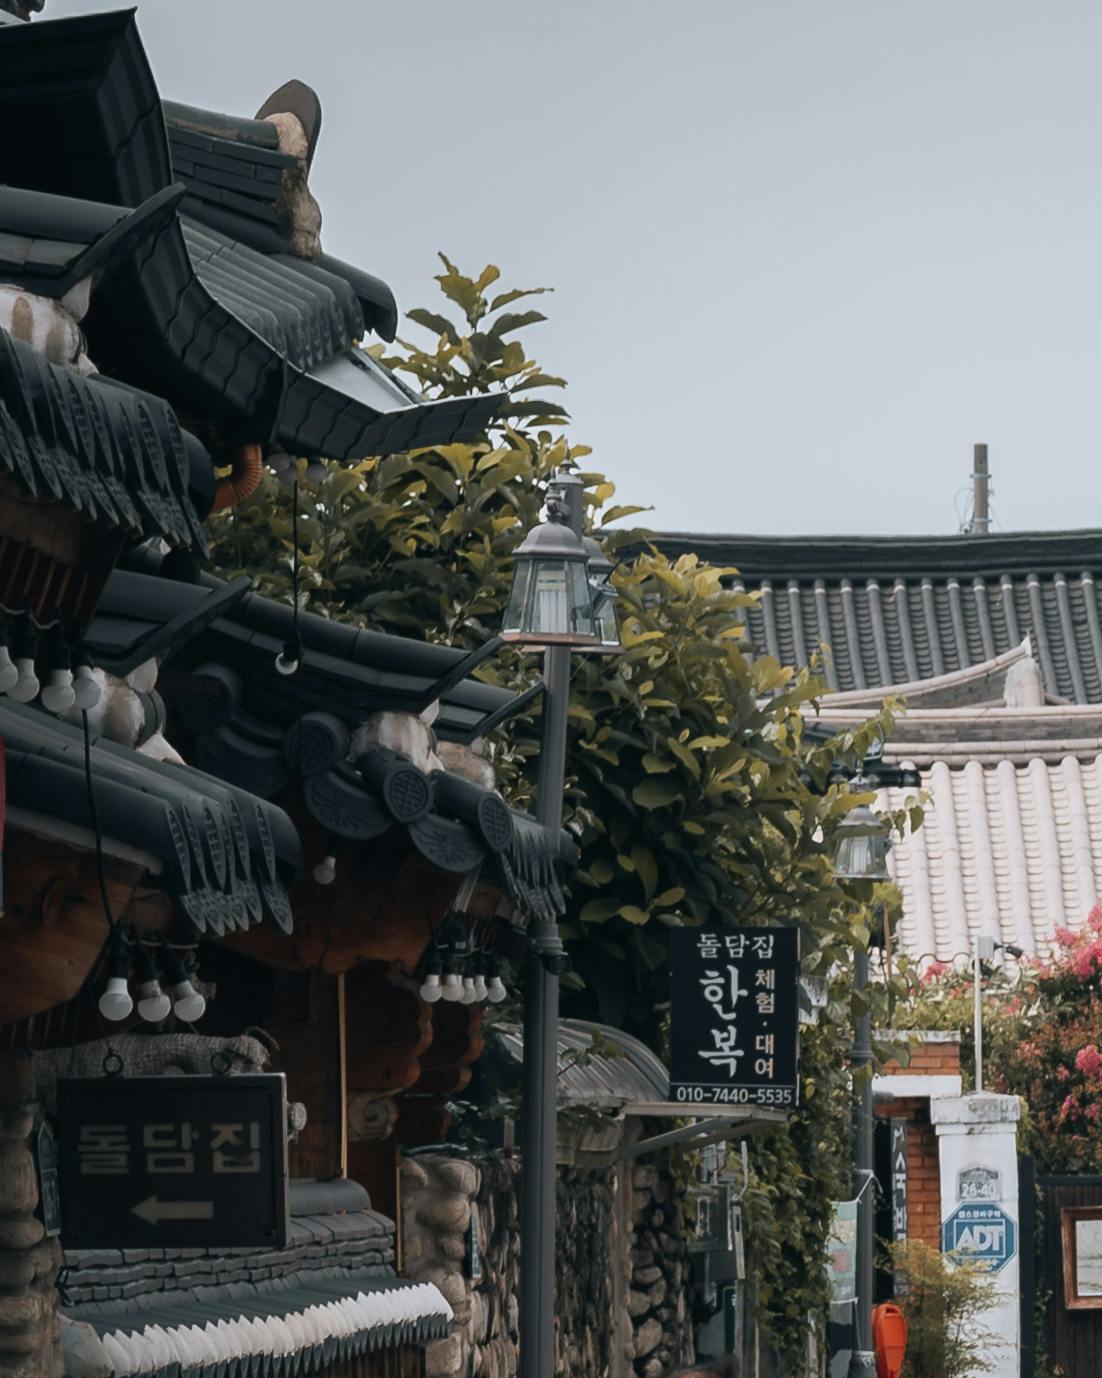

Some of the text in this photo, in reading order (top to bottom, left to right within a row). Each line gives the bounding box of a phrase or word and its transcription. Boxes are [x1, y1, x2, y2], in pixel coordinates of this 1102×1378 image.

[696, 933, 774, 959] 돌담집
[698, 965, 748, 1078] 한복
[677, 1086, 792, 1103] 010-7440-5535
[77, 1121, 261, 1174] 돌담집
[956, 1225, 1003, 1252] ADT
